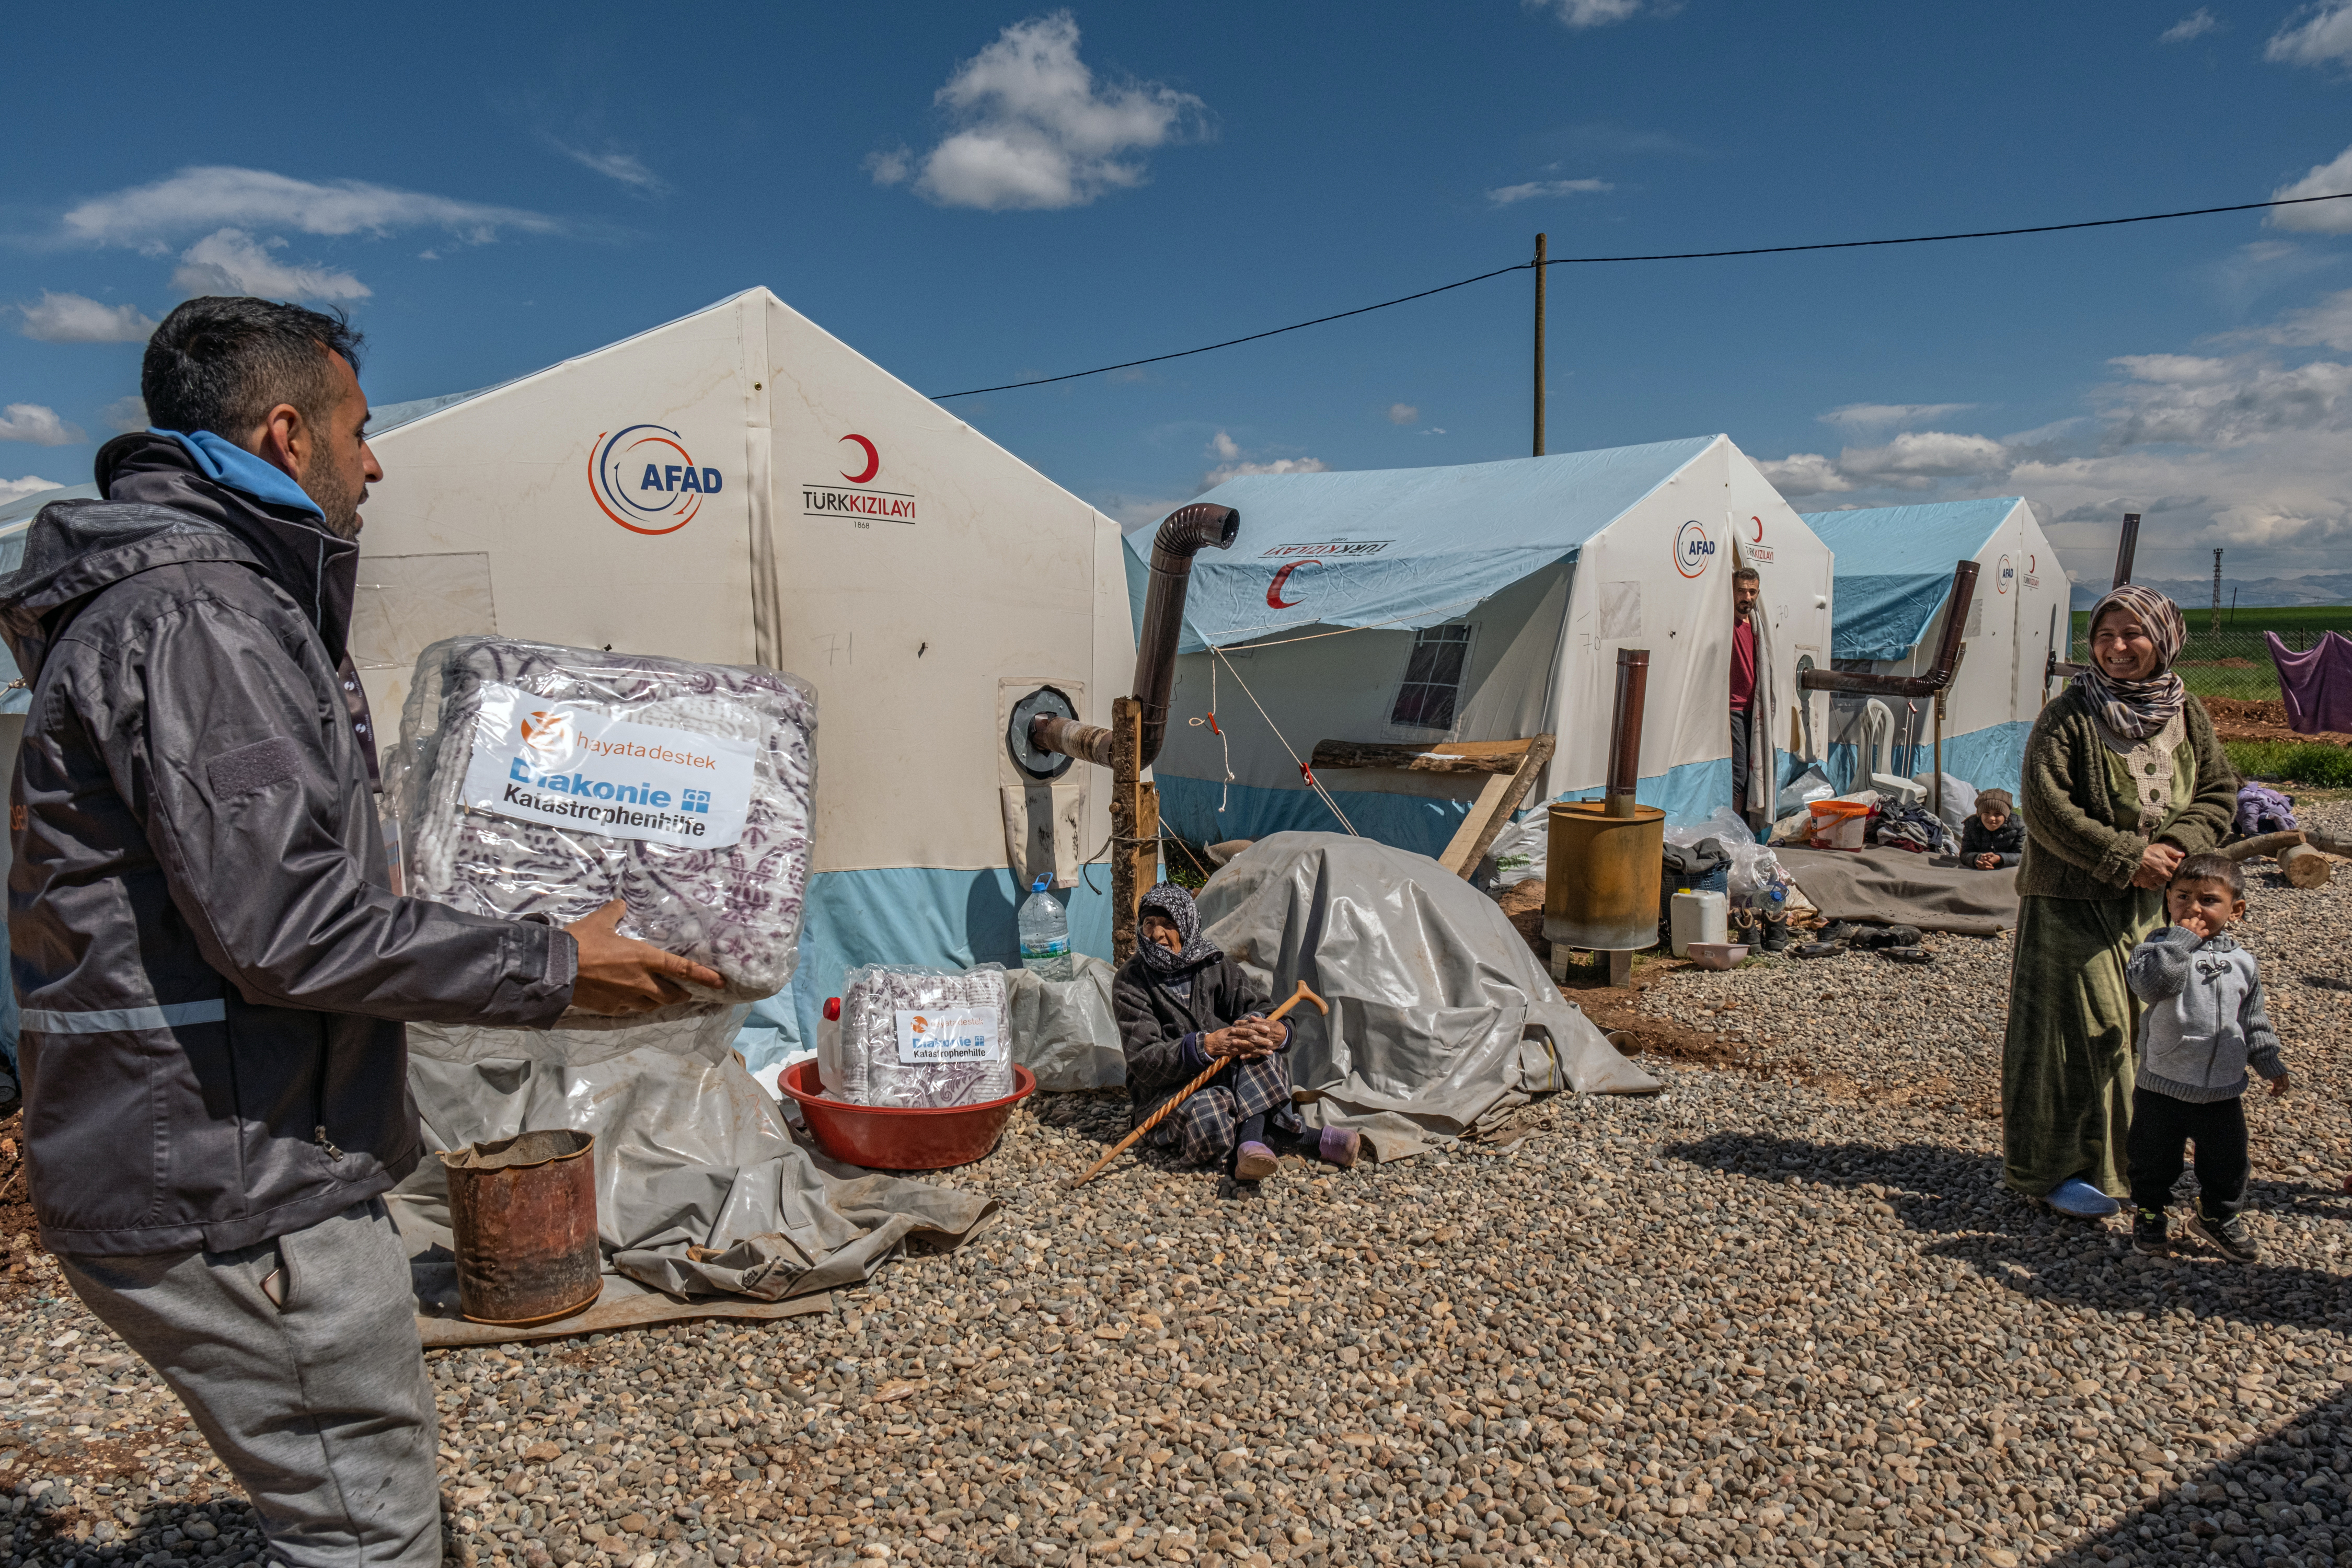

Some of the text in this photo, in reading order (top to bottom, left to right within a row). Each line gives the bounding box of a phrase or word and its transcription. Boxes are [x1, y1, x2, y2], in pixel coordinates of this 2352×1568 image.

[640, 464, 723, 494] AFAD
[802, 491, 916, 518] TÜRKKIZILAYI
[1689, 540, 1715, 555] AFAD
[1745, 546, 1774, 561] TRKKIZILAYI
[2002, 568, 2013, 578] AFAD
[1777, 605, 1789, 621] 70
[1579, 633, 1601, 655] 70
[577, 731, 716, 770] hayatadestek
[509, 757, 672, 808] Diakonie
[503, 783, 706, 836] Katastrophenhilfe
[914, 1048, 986, 1058] Katastrophenhilfe
